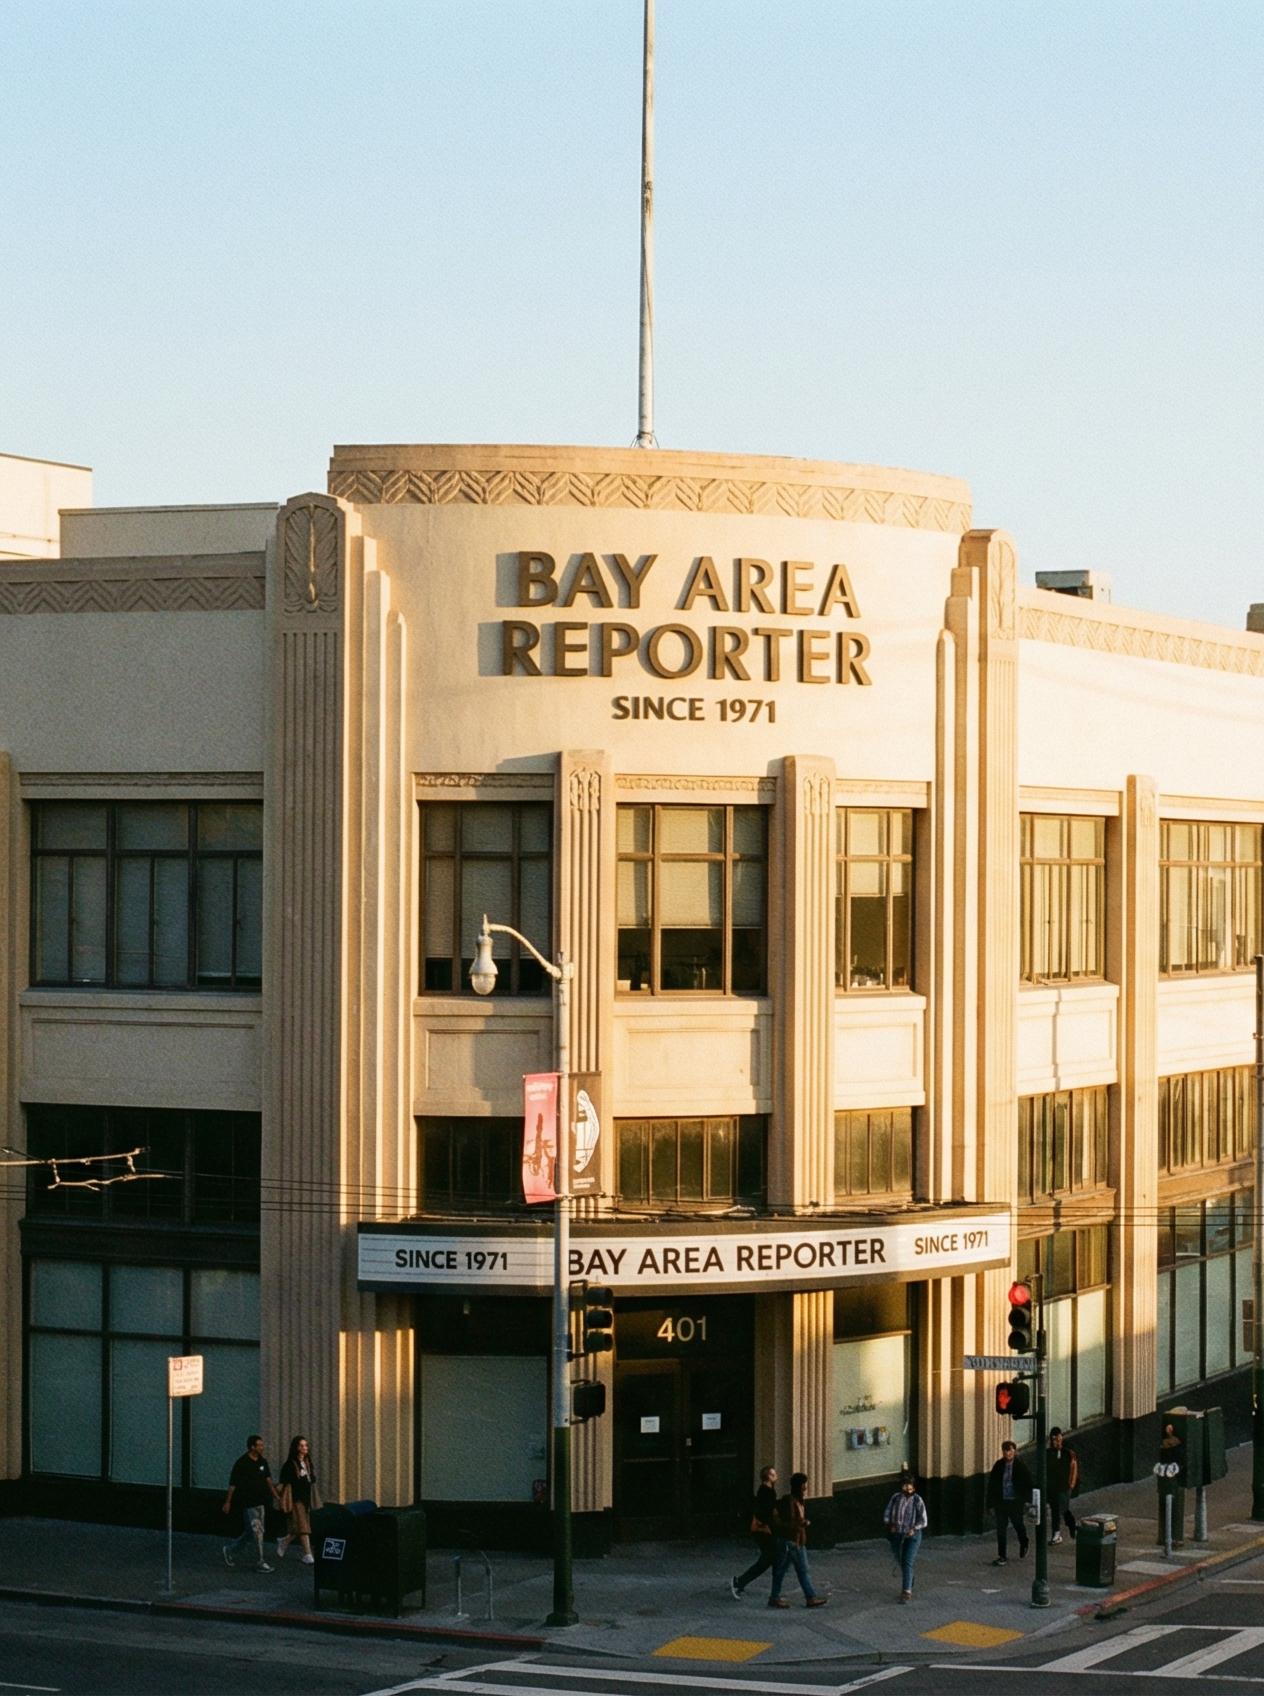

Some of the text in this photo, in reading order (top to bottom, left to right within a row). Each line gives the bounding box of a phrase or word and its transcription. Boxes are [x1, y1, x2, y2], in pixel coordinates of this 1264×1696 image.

[517, 551, 861, 619] BAY AREA
[501, 619, 873, 686] REPORTER
[611, 695, 777, 724] SINCE 1971
[568, 1237, 887, 1276] BAY AREA REPORTER
[914, 1230, 990, 1256] SINCE 1971
[394, 1248, 508, 1271] SINCE 1971
[656, 1315, 707, 1343] 401
